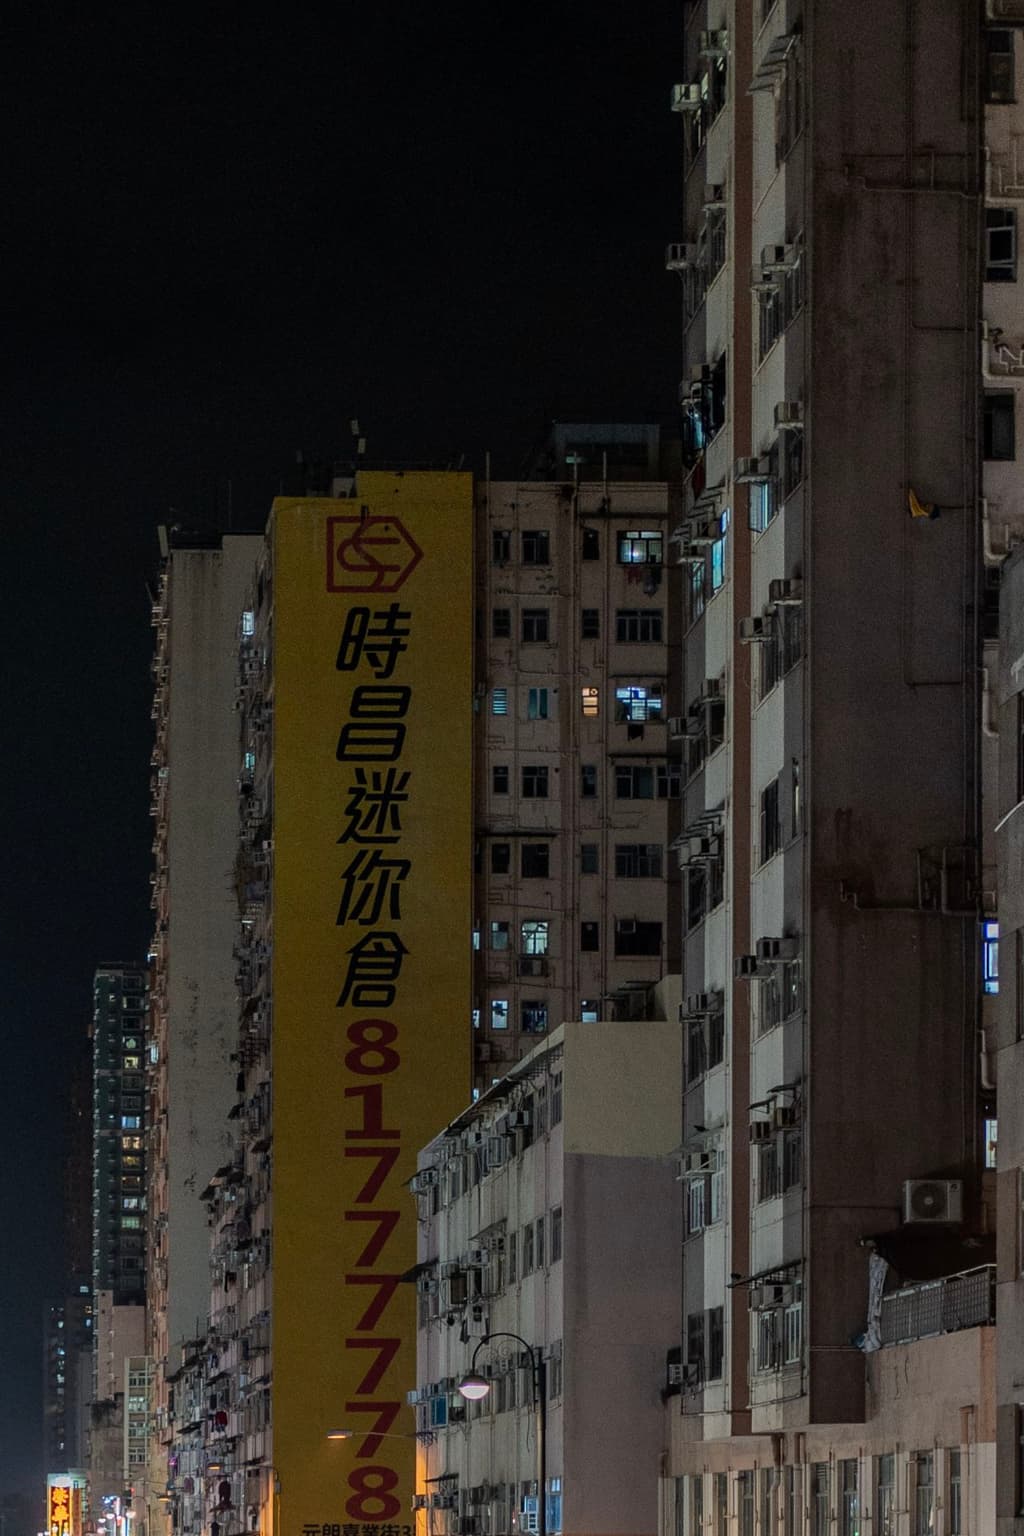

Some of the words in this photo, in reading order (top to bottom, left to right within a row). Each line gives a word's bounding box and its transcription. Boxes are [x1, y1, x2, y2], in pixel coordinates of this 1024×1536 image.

[335, 602, 412, 1009] 時昌迷你倉
[343, 1018, 402, 1522] 81777778
